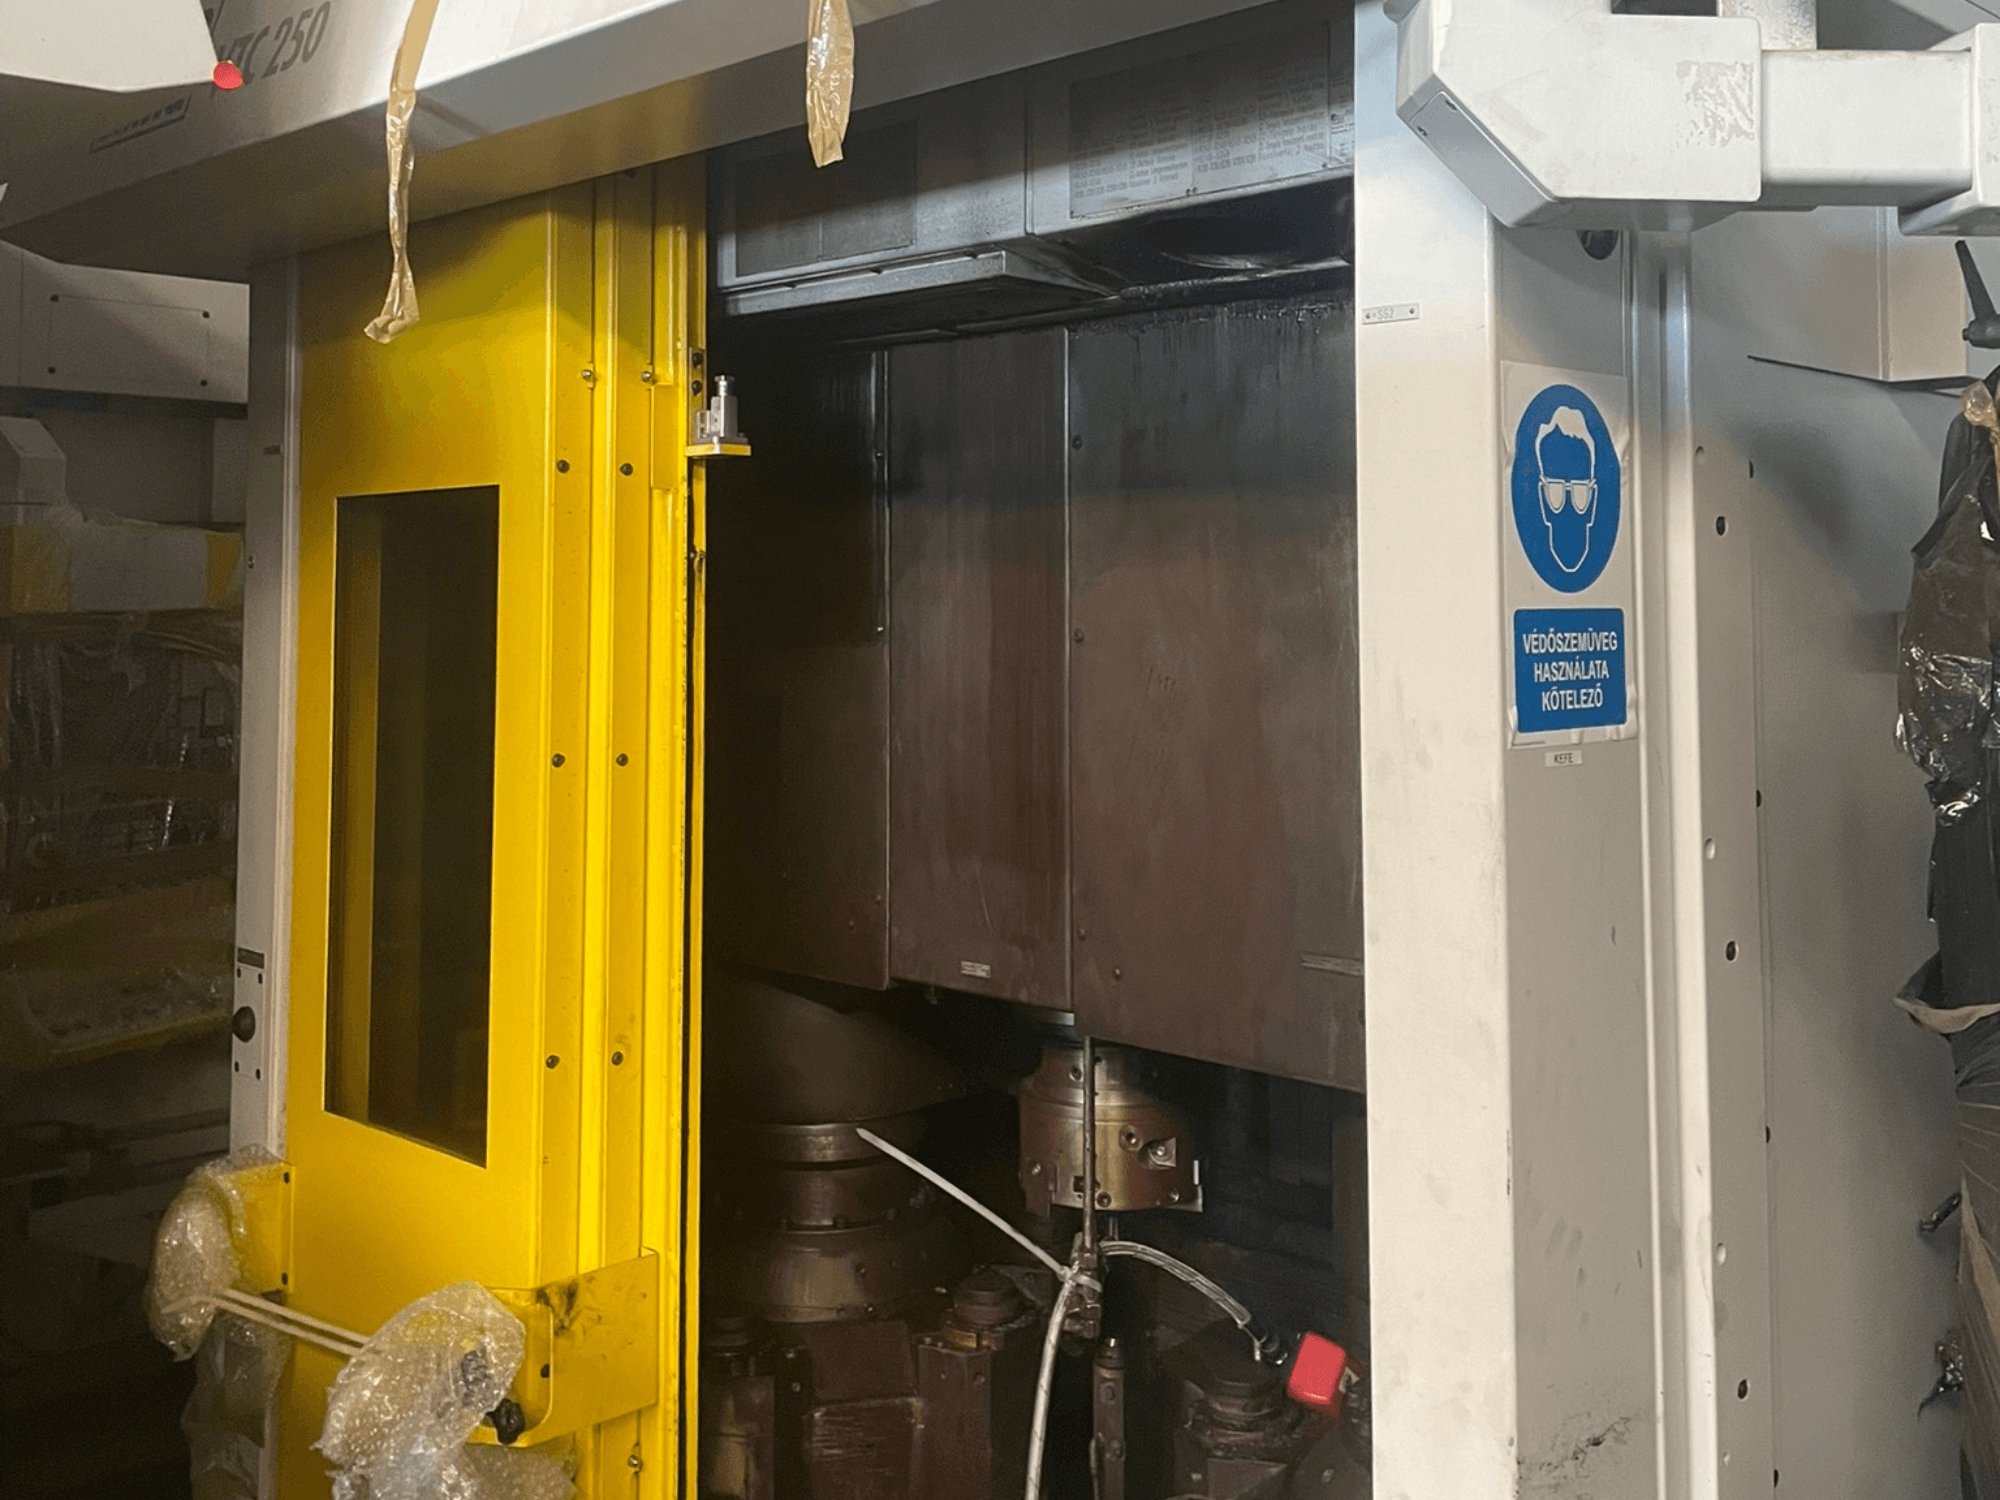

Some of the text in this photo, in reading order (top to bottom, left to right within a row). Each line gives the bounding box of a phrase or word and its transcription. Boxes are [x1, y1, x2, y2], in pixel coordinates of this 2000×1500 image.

[261, 1, 330, 79] 250
[1534, 655, 1609, 682] HASZNÁLATA
[1553, 752, 1573, 763] KEFE
